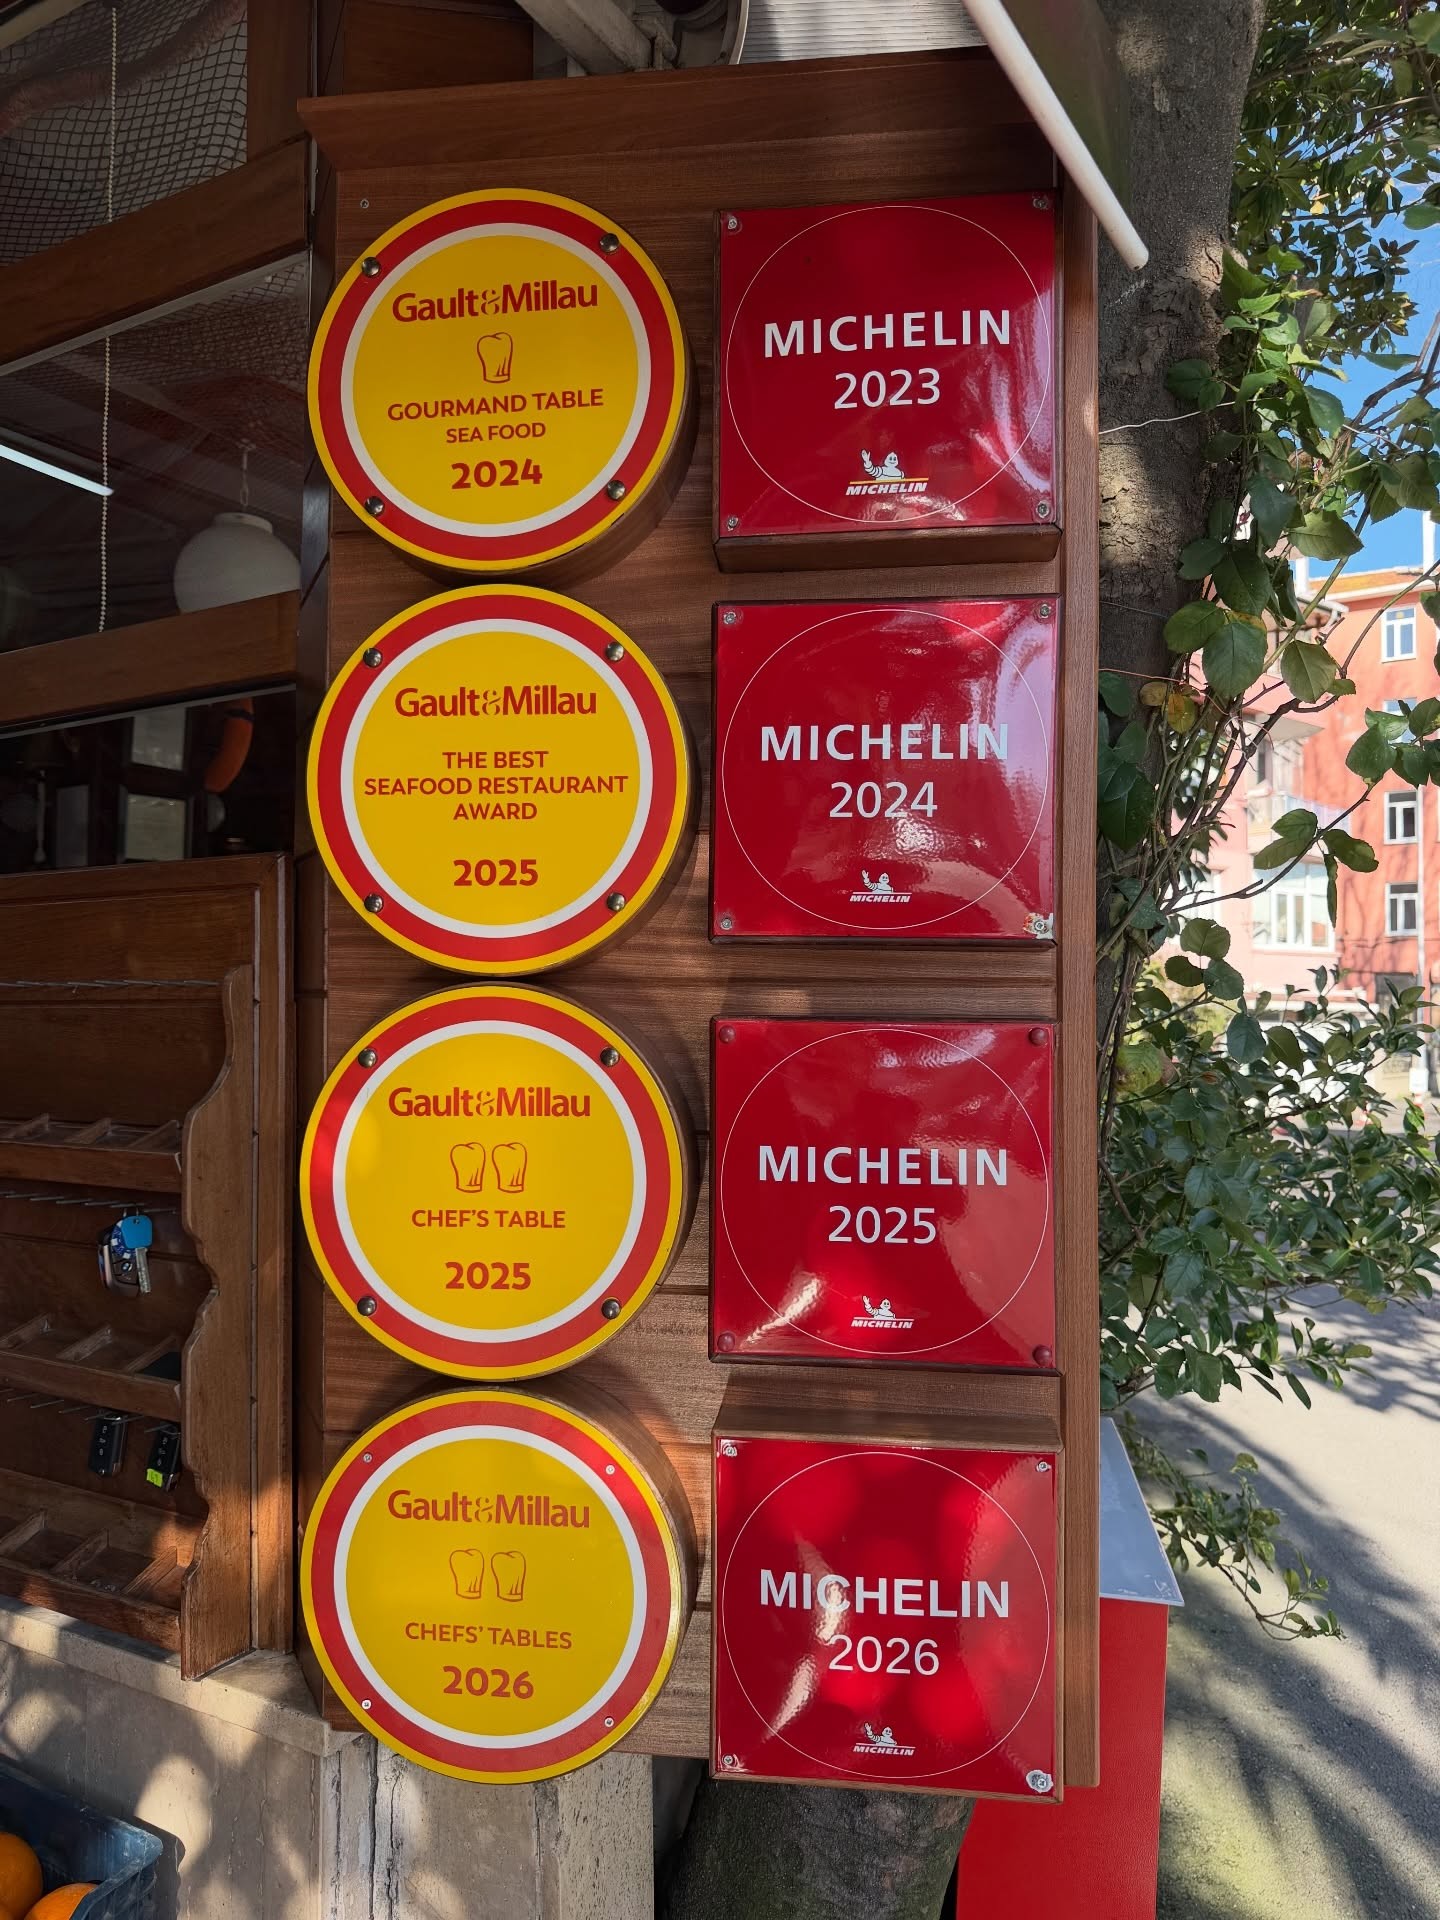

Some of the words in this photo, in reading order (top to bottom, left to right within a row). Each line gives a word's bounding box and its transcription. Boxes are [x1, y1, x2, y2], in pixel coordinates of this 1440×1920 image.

[392, 279, 598, 322] Gault&Millau
[764, 309, 1010, 358] MICHELIN
[834, 368, 941, 409] 2023
[387, 394, 526, 421] GOURMAND
[532, 388, 604, 411] TABLE
[446, 427, 483, 443] SEA
[488, 422, 546, 441] FOOD
[451, 458, 542, 489] 2024
[846, 481, 928, 495] MICHELIN
[395, 685, 597, 717] Gault&Millau
[761, 723, 1009, 761] MICHELIN
[442, 752, 488, 769] THE
[494, 751, 549, 768] BEST
[364, 778, 472, 795] SEAFOOD
[478, 776, 628, 794] RESTAURANT
[829, 781, 937, 818] 2024
[453, 802, 538, 820] AWARD
[453, 859, 538, 886] 2025
[849, 894, 911, 903] MICHELIN
[388, 1087, 591, 1118] Gault&Millau
[758, 1145, 1007, 1186] MICHELIN
[494, 1210, 566, 1229] TABLE
[828, 1205, 936, 1244] 2025
[445, 1261, 531, 1290] 2025
[851, 1319, 912, 1328] MICHELIN
[388, 1489, 590, 1528] Gault&Millau
[760, 1569, 1009, 1618] MICHELIN
[488, 1628, 572, 1650] TABLES
[829, 1634, 940, 1675] 2026
[443, 1665, 534, 1699] 2026
[853, 1746, 915, 1756] MICHELIN
